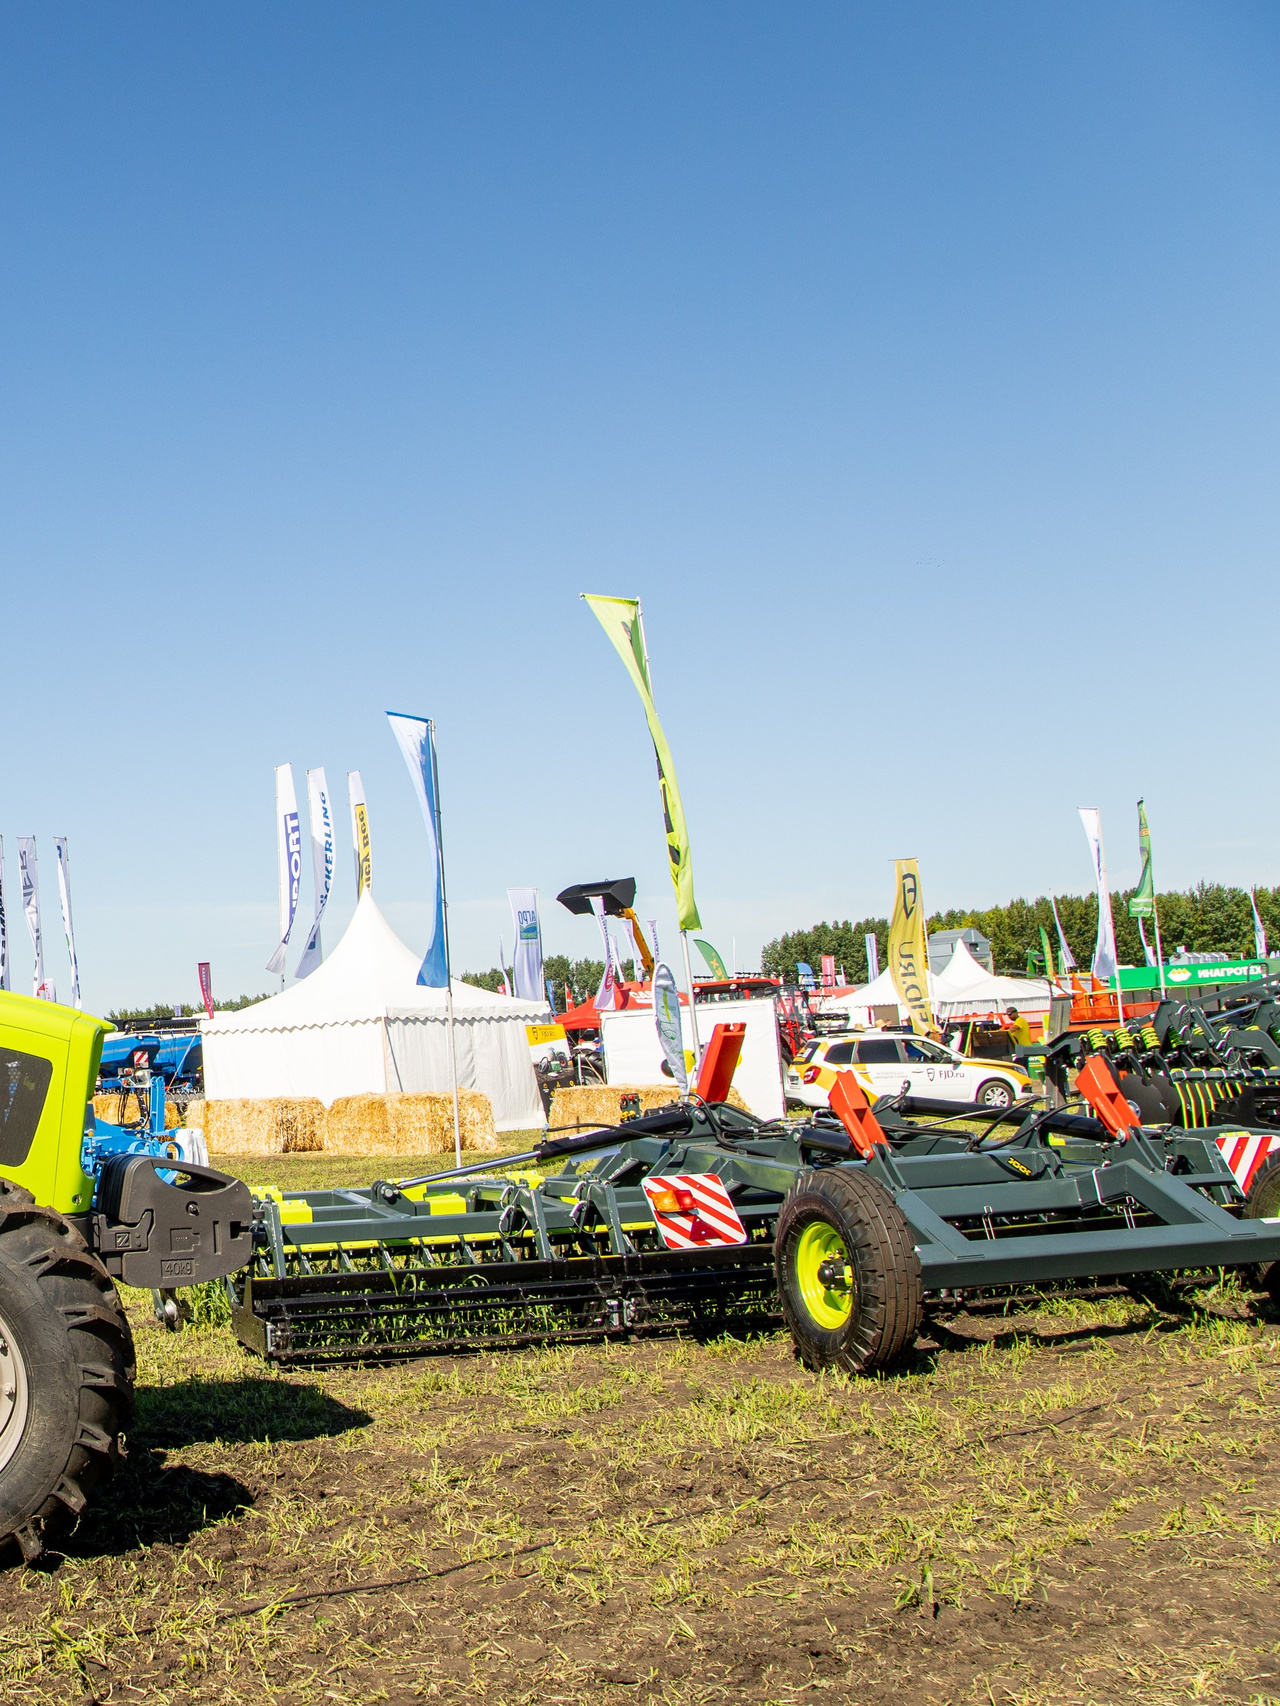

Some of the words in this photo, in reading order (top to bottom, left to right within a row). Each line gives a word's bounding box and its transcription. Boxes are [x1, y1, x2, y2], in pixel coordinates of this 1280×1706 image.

[312, 791, 334, 934] ÖCKERLING
[1197, 965, 1263, 978] ИНАГРОТЕХ
[629, 990, 652, 999] CAS
[939, 1070, 965, 1079] FJD.ru
[164, 1262, 193, 1276] 40kg
